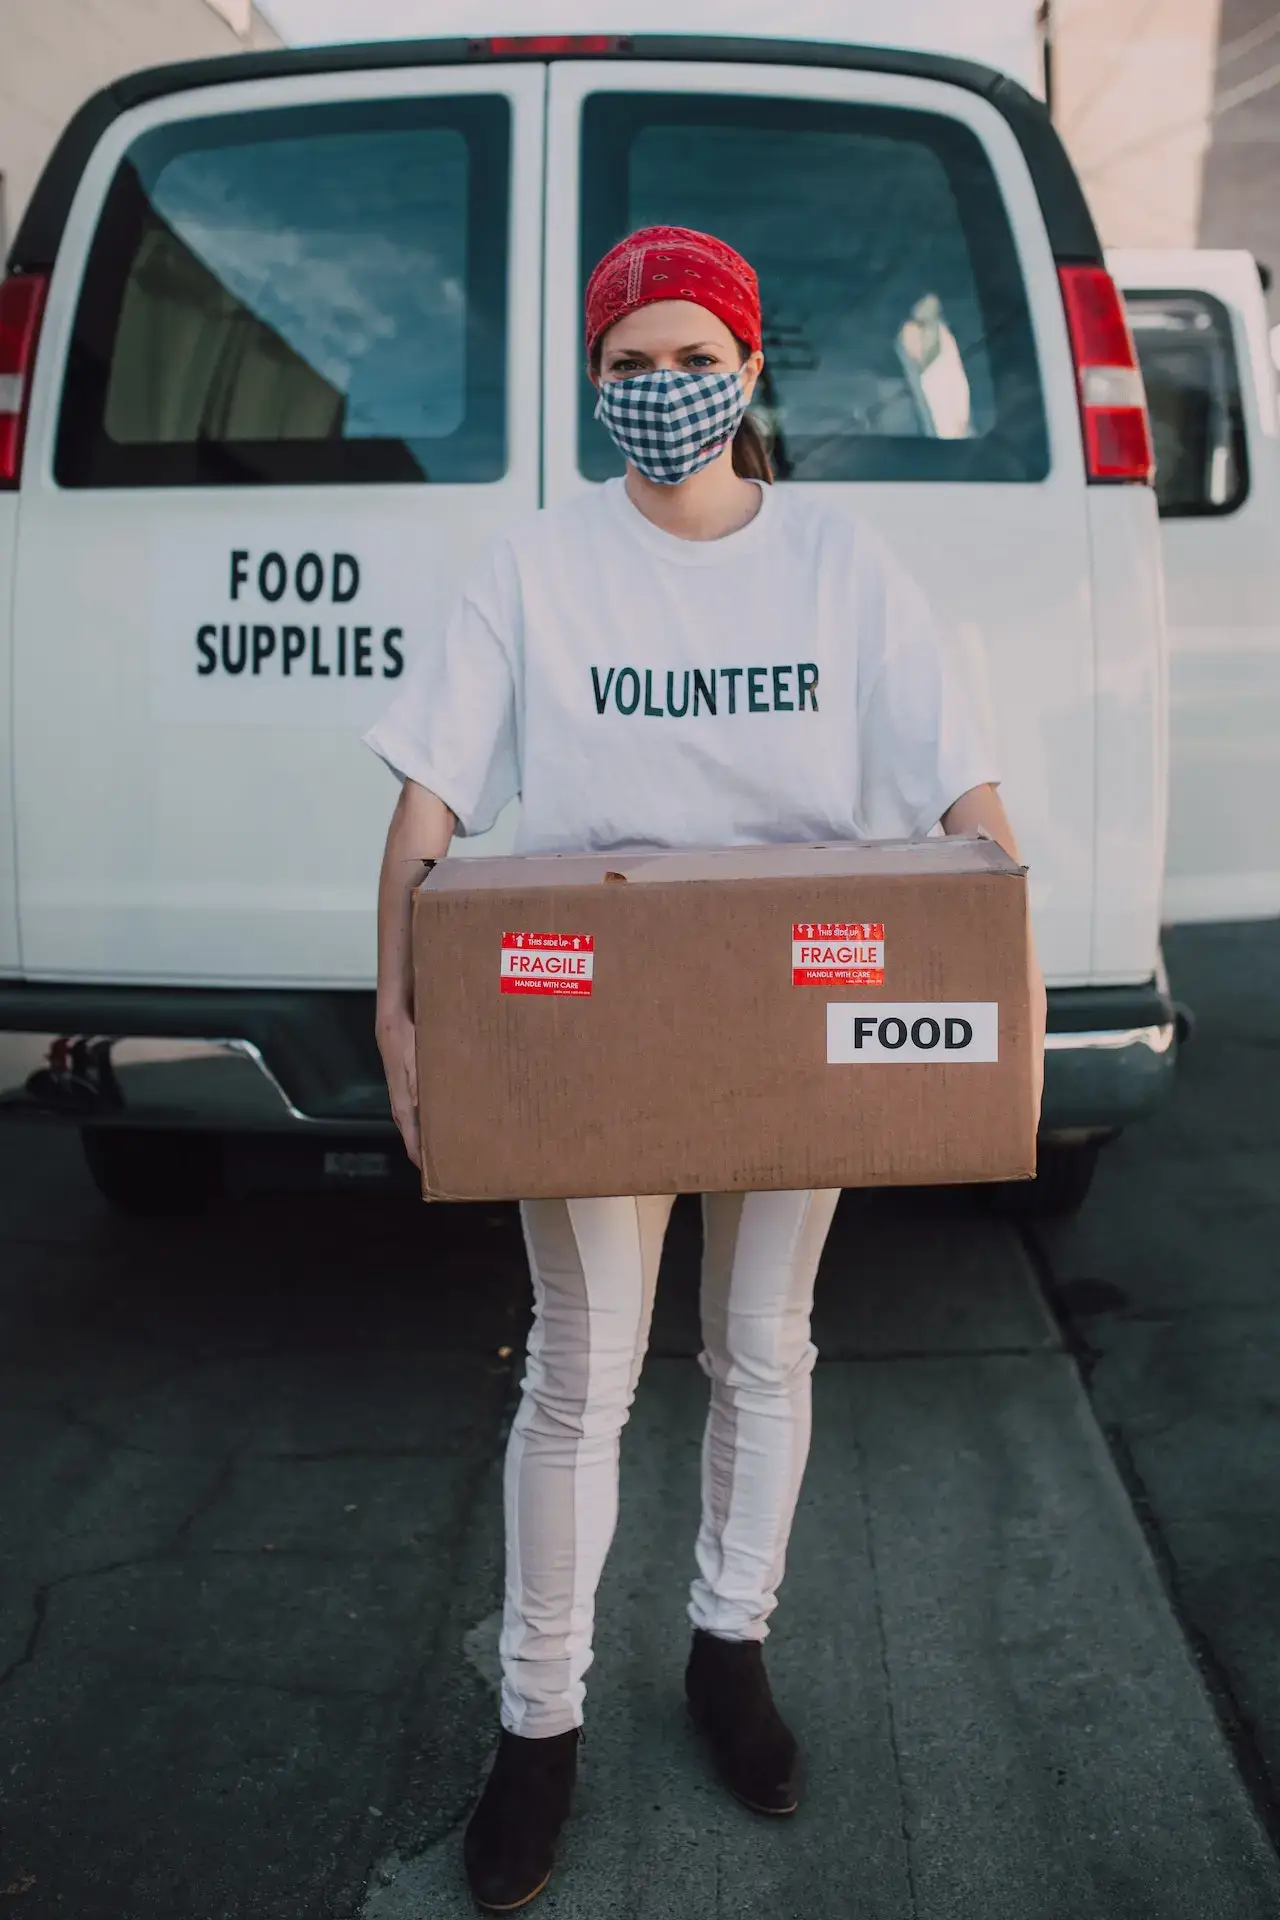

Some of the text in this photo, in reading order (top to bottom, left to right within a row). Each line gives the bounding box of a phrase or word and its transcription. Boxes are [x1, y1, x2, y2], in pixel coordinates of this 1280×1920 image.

[229, 550, 360, 603] FOOD
[196, 624, 405, 678] SUPPLIES
[590, 662, 819, 718] VOLUNTEER
[543, 939, 558, 947] SIDE
[850, 929, 859, 937] UP
[510, 955, 586, 975] FRAGILE
[801, 947, 877, 963] FRAGILE
[515, 980, 579, 989] HANDLE WITH CARE
[854, 1017, 973, 1050] FOOD
